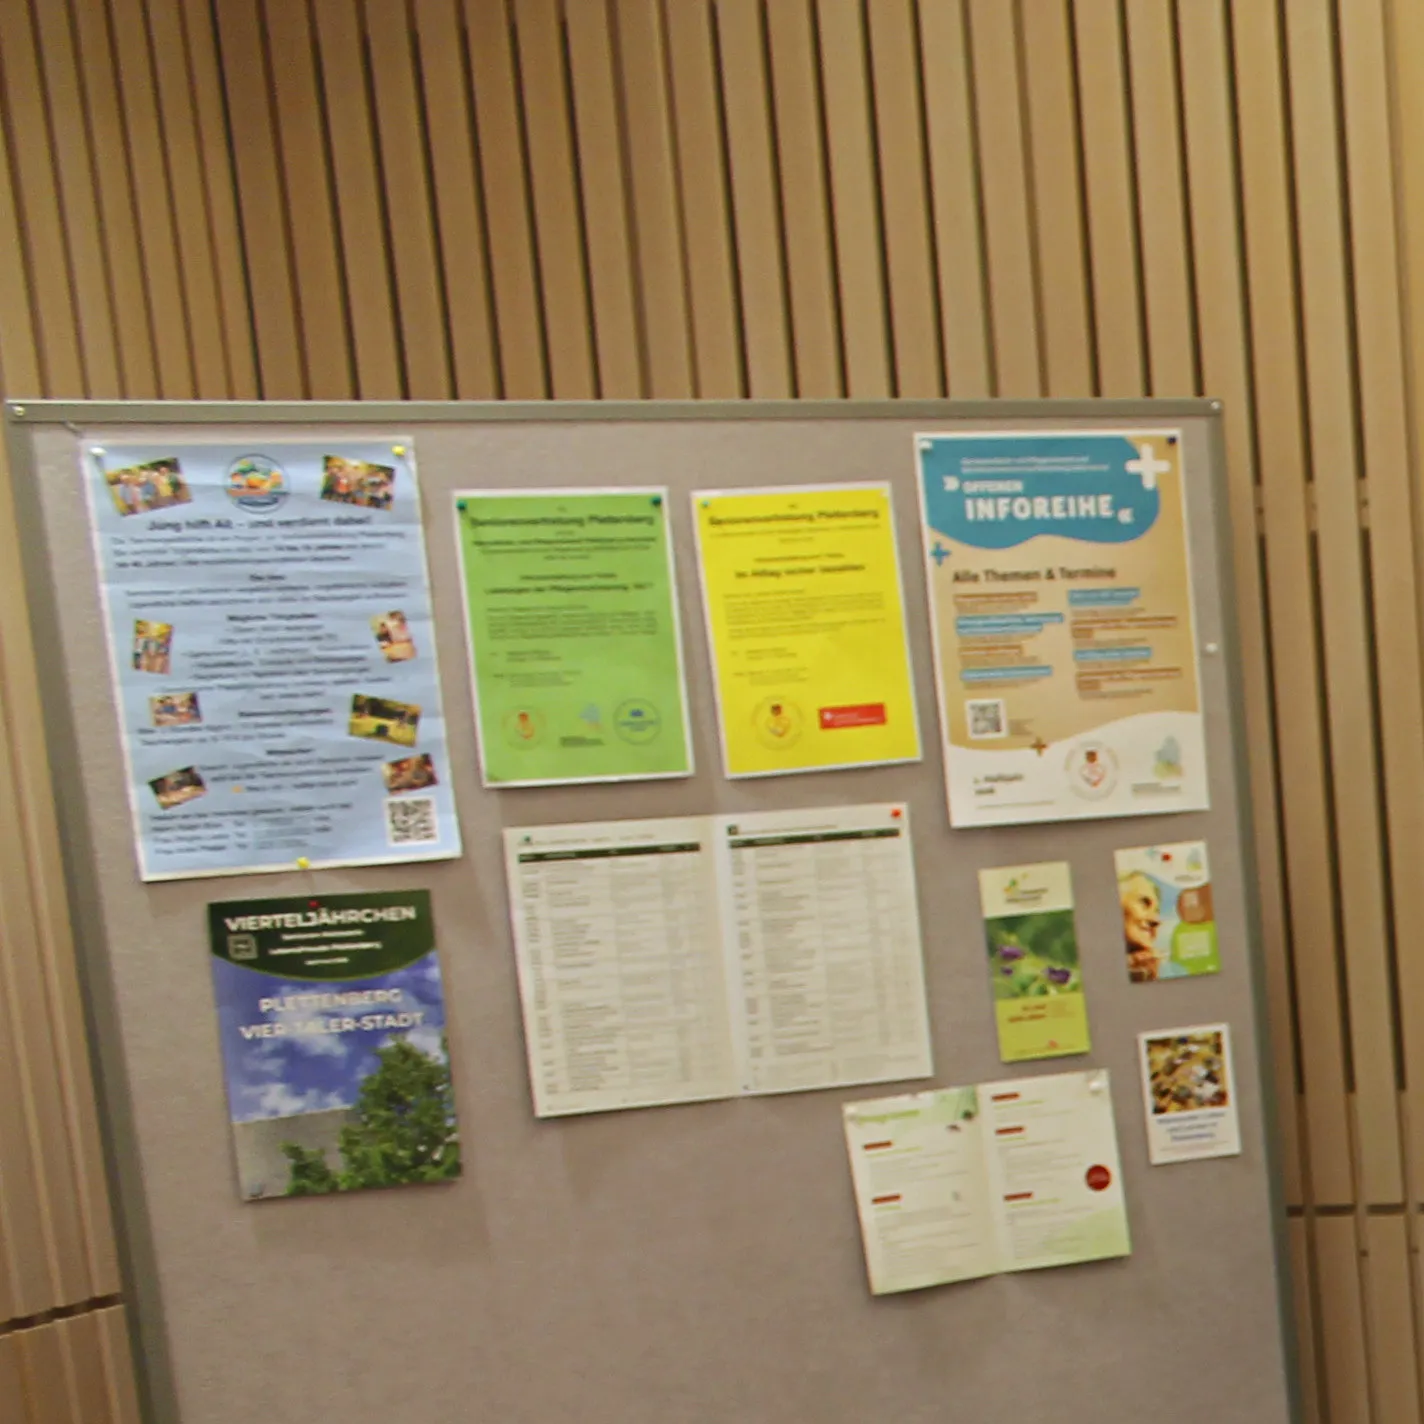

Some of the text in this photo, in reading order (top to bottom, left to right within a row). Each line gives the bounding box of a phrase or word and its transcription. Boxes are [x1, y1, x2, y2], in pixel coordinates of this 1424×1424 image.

[983, 568, 1040, 582] Themen
[1058, 566, 1117, 579] Termine
[224, 906, 417, 932] VIERTELJÄHRCHEN
